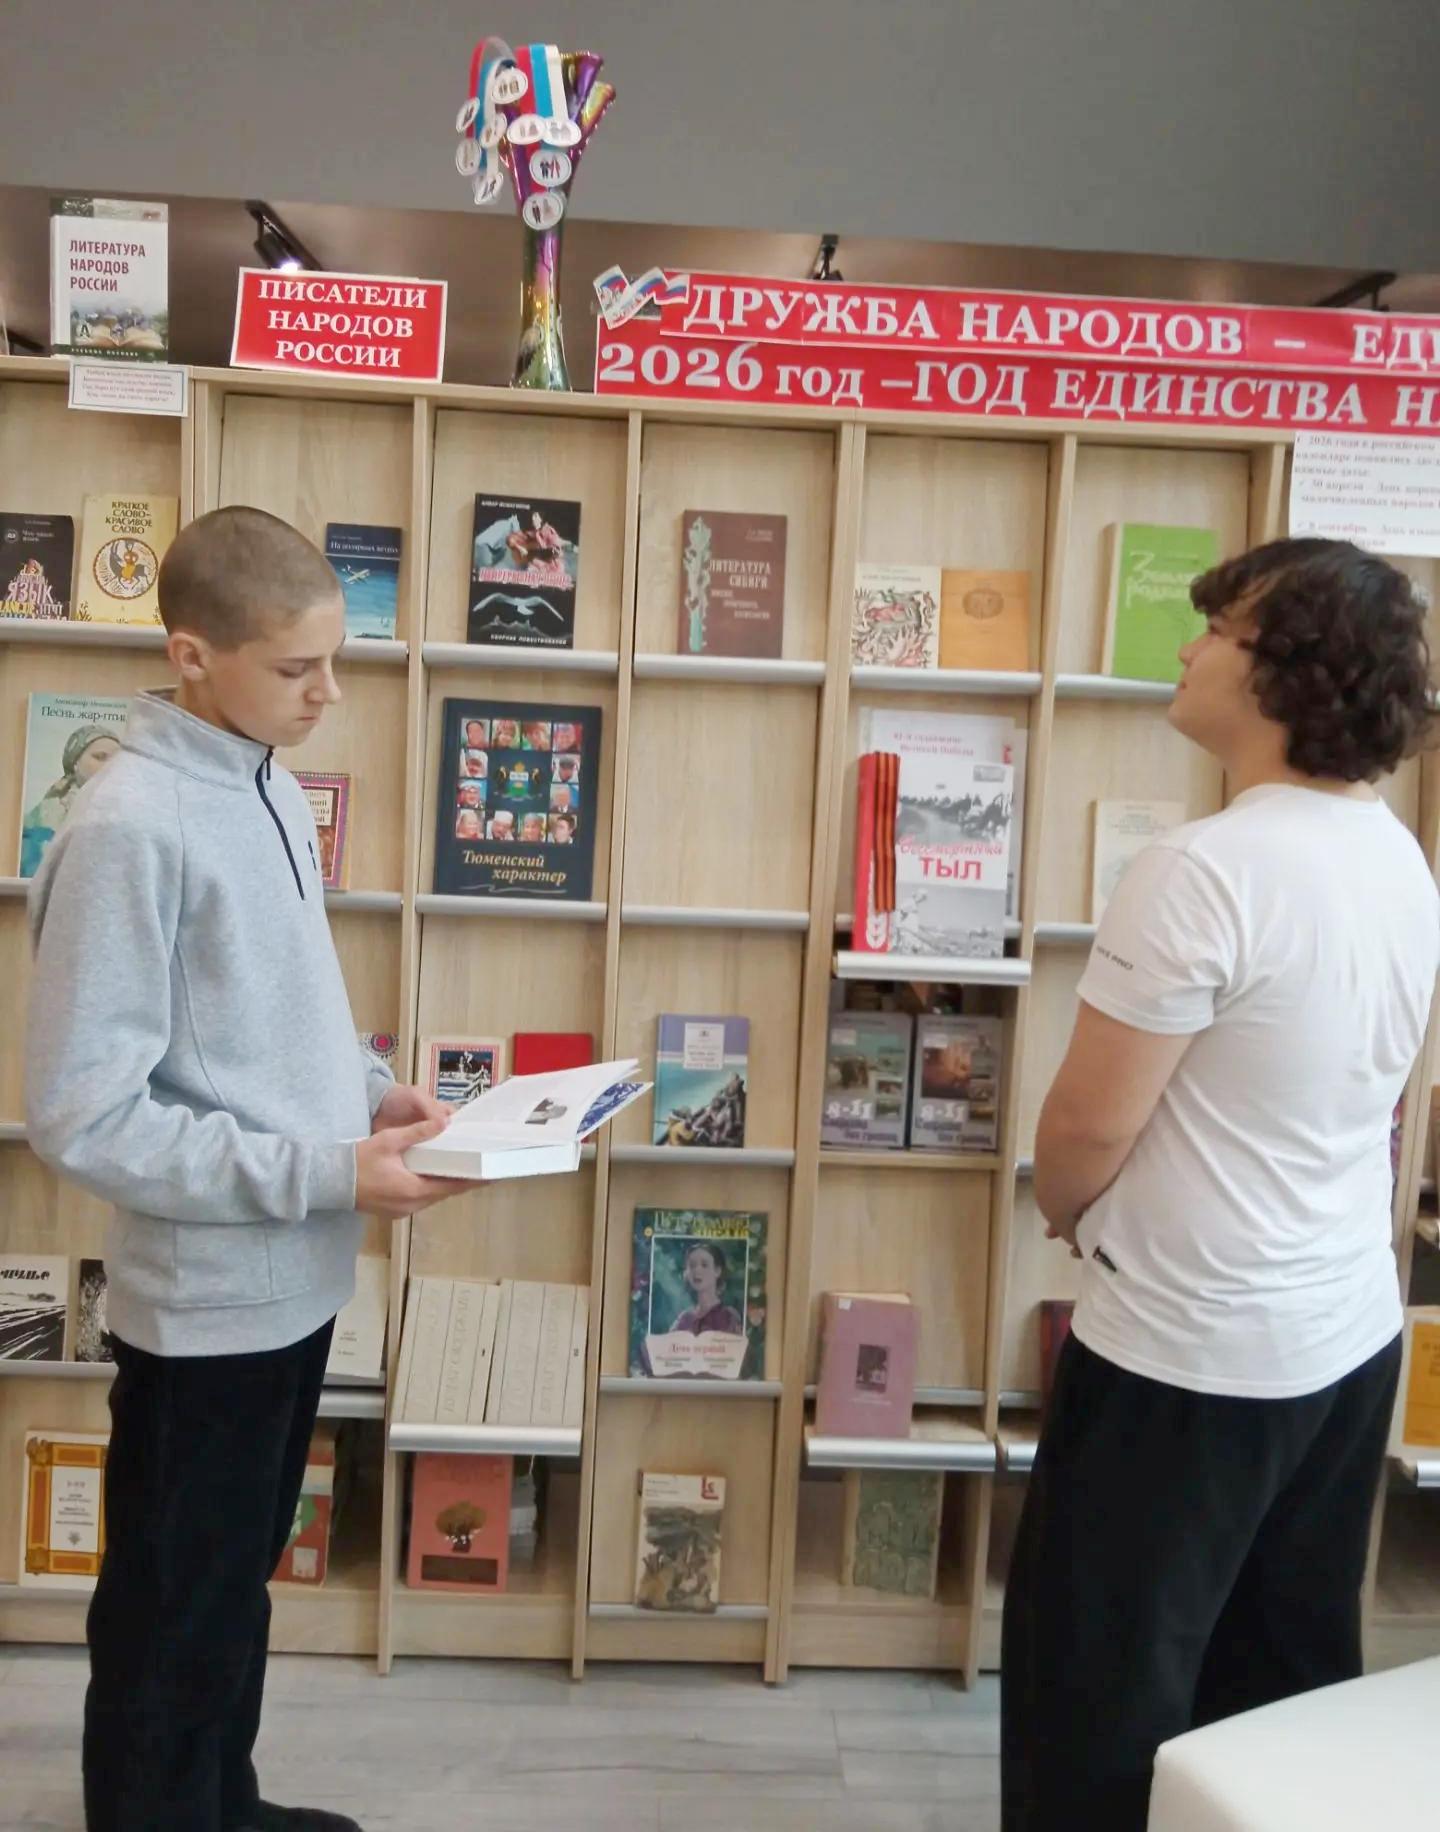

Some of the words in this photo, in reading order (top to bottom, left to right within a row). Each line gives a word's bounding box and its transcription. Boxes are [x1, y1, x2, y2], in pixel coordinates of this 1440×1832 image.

[70, 240, 146, 257] ЛИТЕРАТУРА
[70, 258, 129, 275] НАРОДОВ
[70, 276, 118, 292] РОССИИ
[258, 279, 428, 309] ПИСАТЕЛИ
[267, 309, 414, 339] НАРОДОВ
[683, 284, 940, 339] ДРУЖБА
[957, 301, 1242, 357] НАРОДОВ
[274, 340, 401, 368] РОССИИ
[600, 342, 763, 392] 2026
[774, 364, 865, 408] год
[1049, 368, 1368, 424] ЕДИНСТВА
[1390, 384, 1440, 428] Н
[111, 501, 149, 511] КРАТКОЕ
[105, 517, 153, 528] КРАСИВОЕ
[111, 525, 145, 534] СЛОВО
[708, 559, 771, 575] ЛИТЕРАТУРА
[7, 582, 54, 604] ЯЗЫК
[41, 706, 75, 720] Песнь
[462, 850, 545, 868] Тюменский
[919, 856, 982, 880] ТЫЛ
[491, 867, 567, 885] характер
